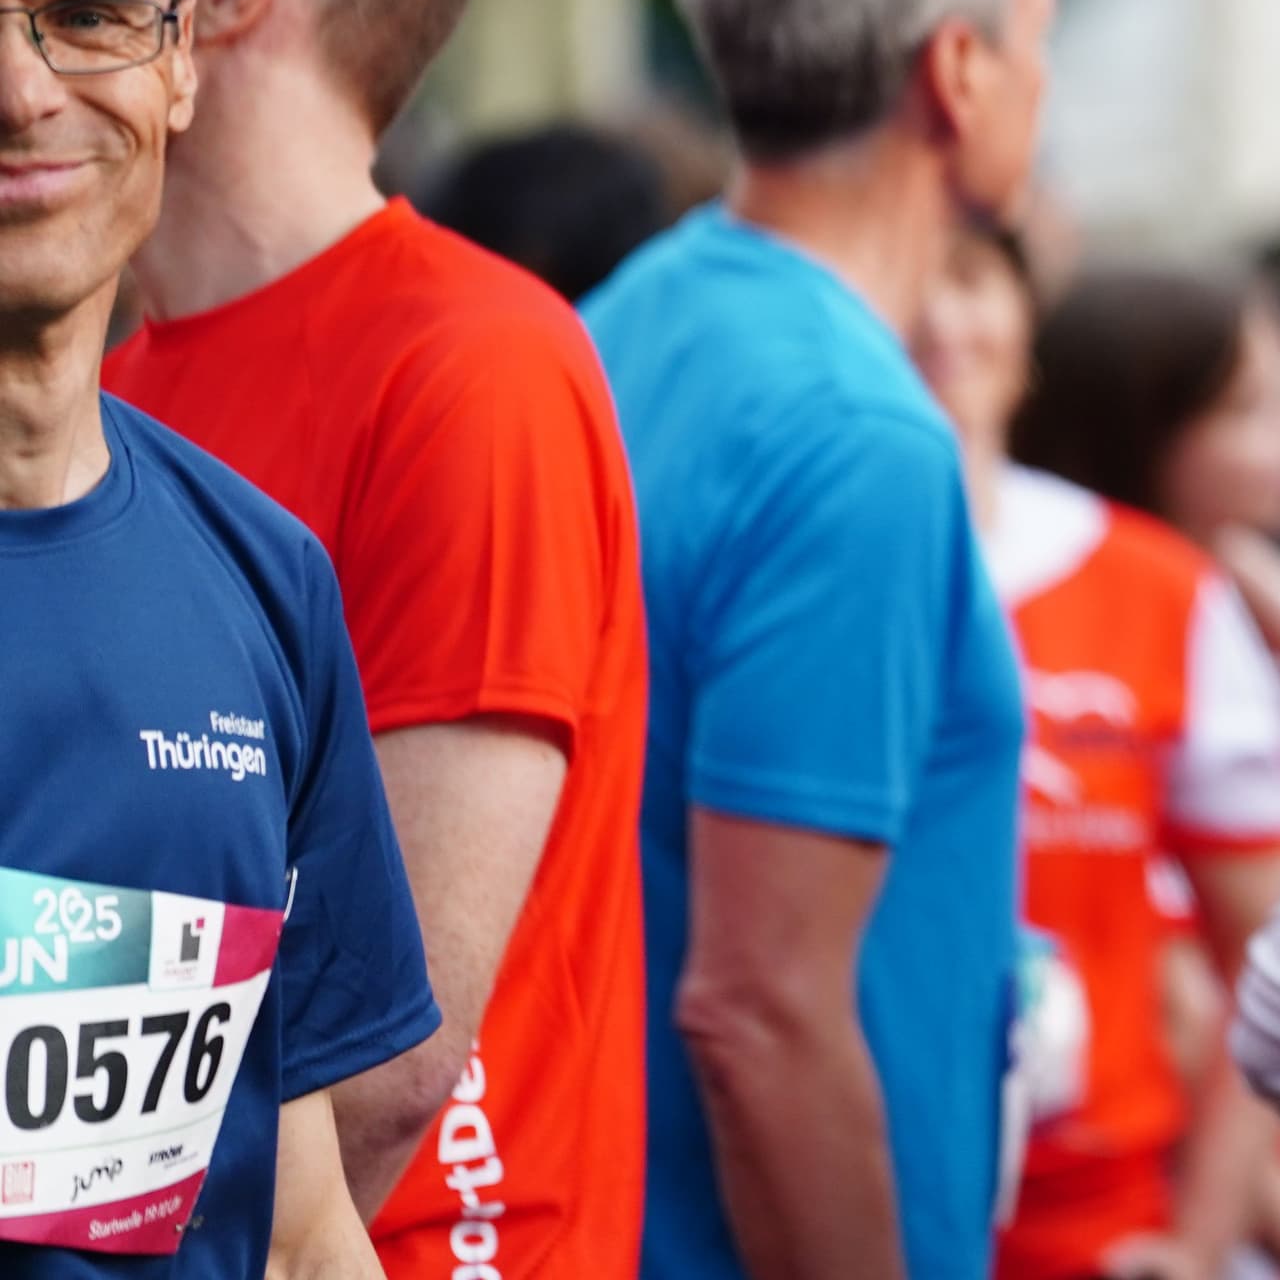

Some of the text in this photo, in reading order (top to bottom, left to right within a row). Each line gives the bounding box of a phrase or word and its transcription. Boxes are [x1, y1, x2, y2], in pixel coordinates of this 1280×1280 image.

[139, 729, 267, 783] Thüringen
[5, 1001, 232, 1131] 0576
[71, 1157, 124, 1203] jump
